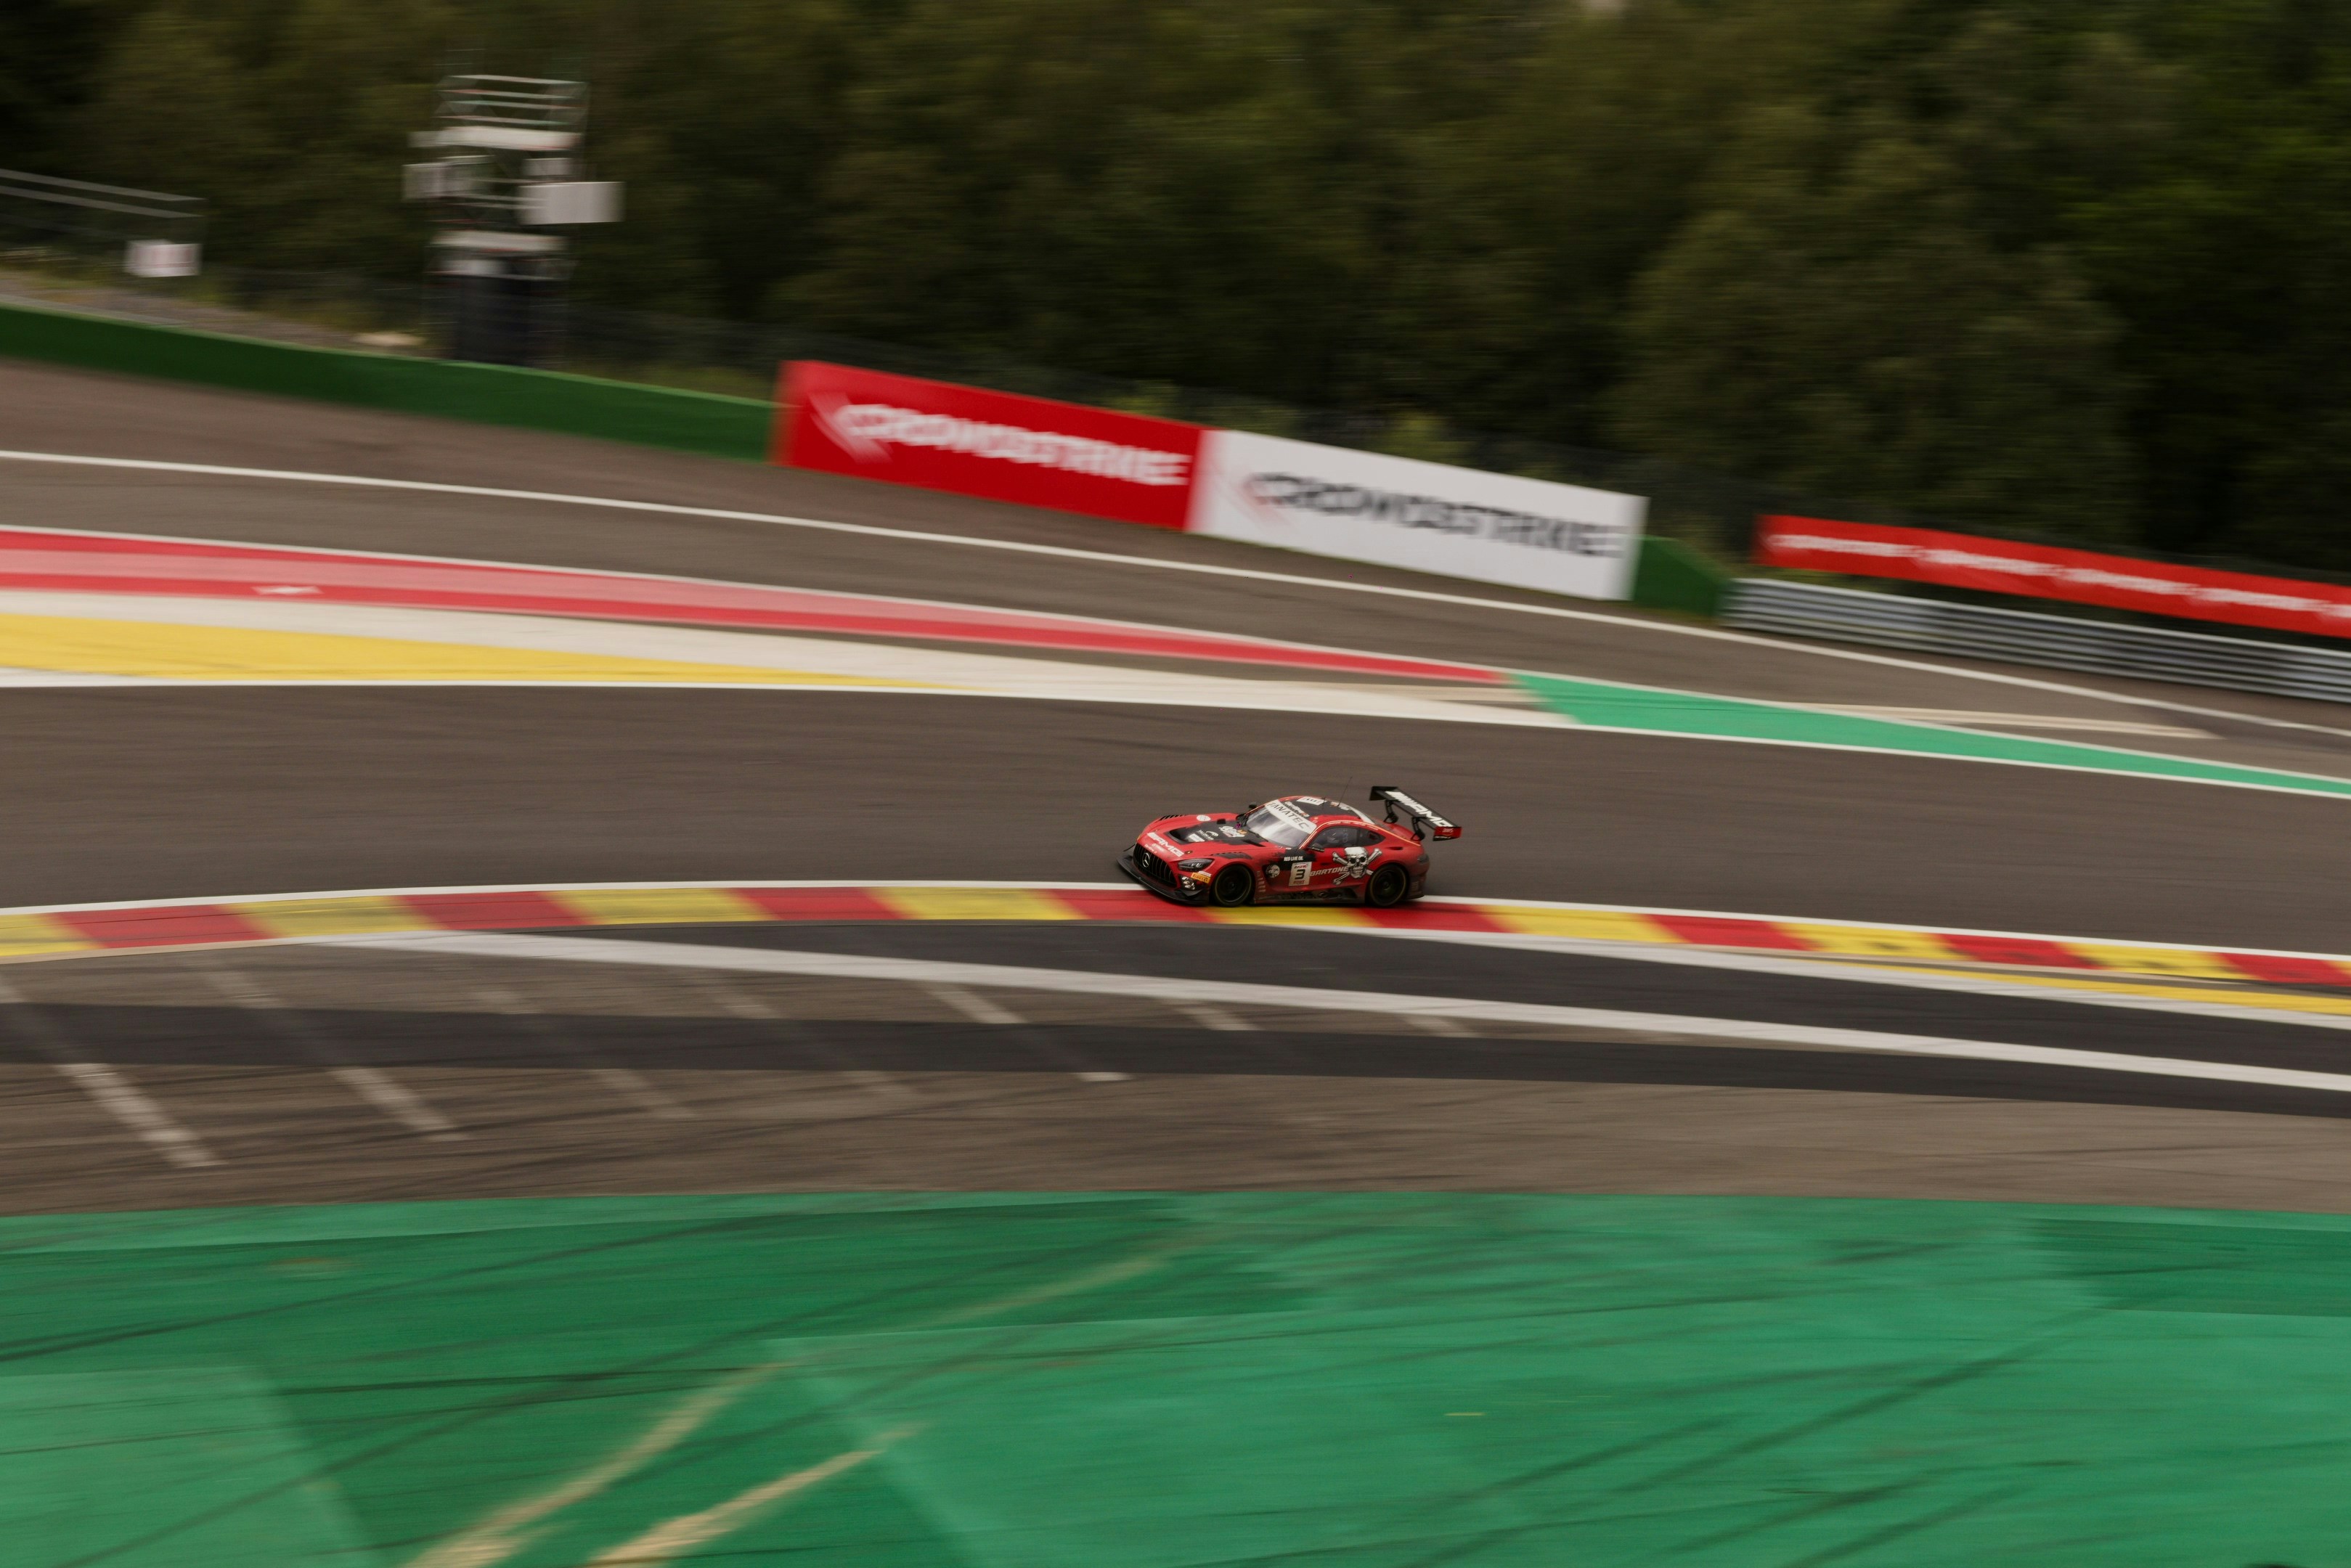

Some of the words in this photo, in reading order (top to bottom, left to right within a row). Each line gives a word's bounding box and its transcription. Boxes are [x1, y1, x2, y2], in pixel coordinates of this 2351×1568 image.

[1268, 801, 1310, 829] FANATEC
[1155, 835, 1185, 857] AMG
[1295, 869, 1305, 880] 3
[1309, 865, 1350, 877] BARTONE
